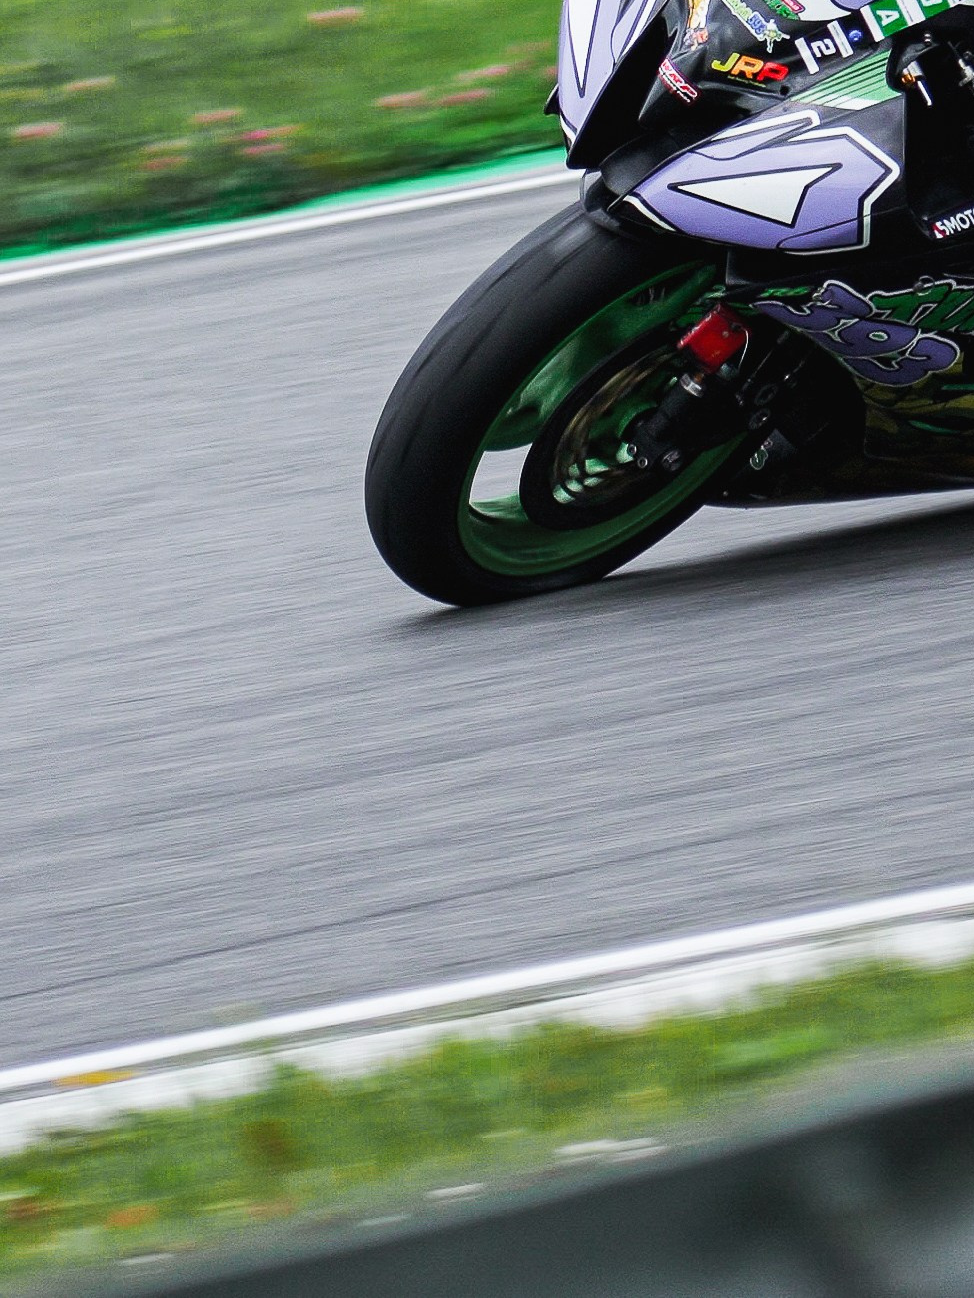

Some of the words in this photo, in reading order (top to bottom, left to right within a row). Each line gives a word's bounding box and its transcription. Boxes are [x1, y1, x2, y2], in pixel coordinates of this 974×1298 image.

[875, 9, 901, 27] A
[810, 37, 837, 58] 2
[711, 52, 790, 82] JRP
[749, 279, 961, 388] 393
